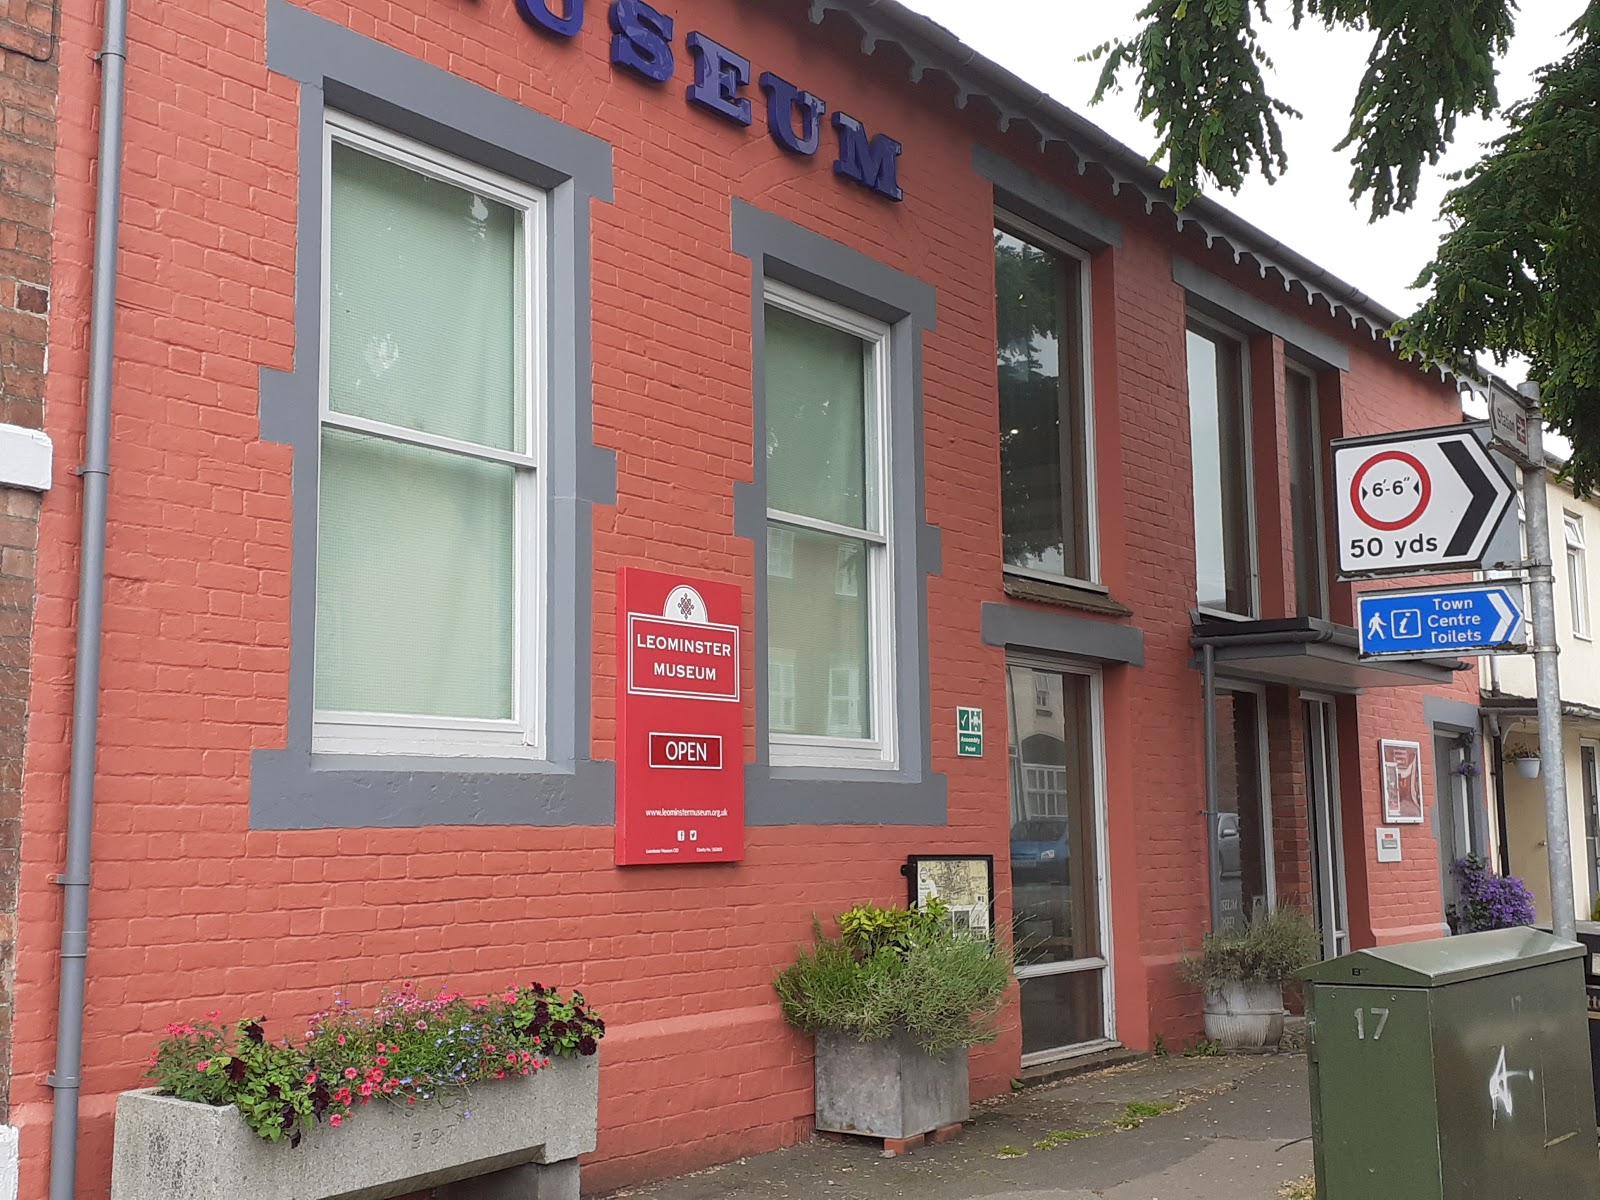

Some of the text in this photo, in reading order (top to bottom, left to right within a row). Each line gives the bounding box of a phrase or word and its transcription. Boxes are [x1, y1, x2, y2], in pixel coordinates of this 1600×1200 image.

[1350, 533, 1438, 559] 50 yds
[1432, 598, 1473, 611] Town
[1427, 613, 1481, 628] Centre
[636, 633, 732, 657] LEOMINSTER
[1431, 629, 1482, 644] Toilets
[653, 662, 717, 681] MUSEUM
[665, 740, 707, 762] OPEN
[1354, 1007, 1390, 1040] 17
